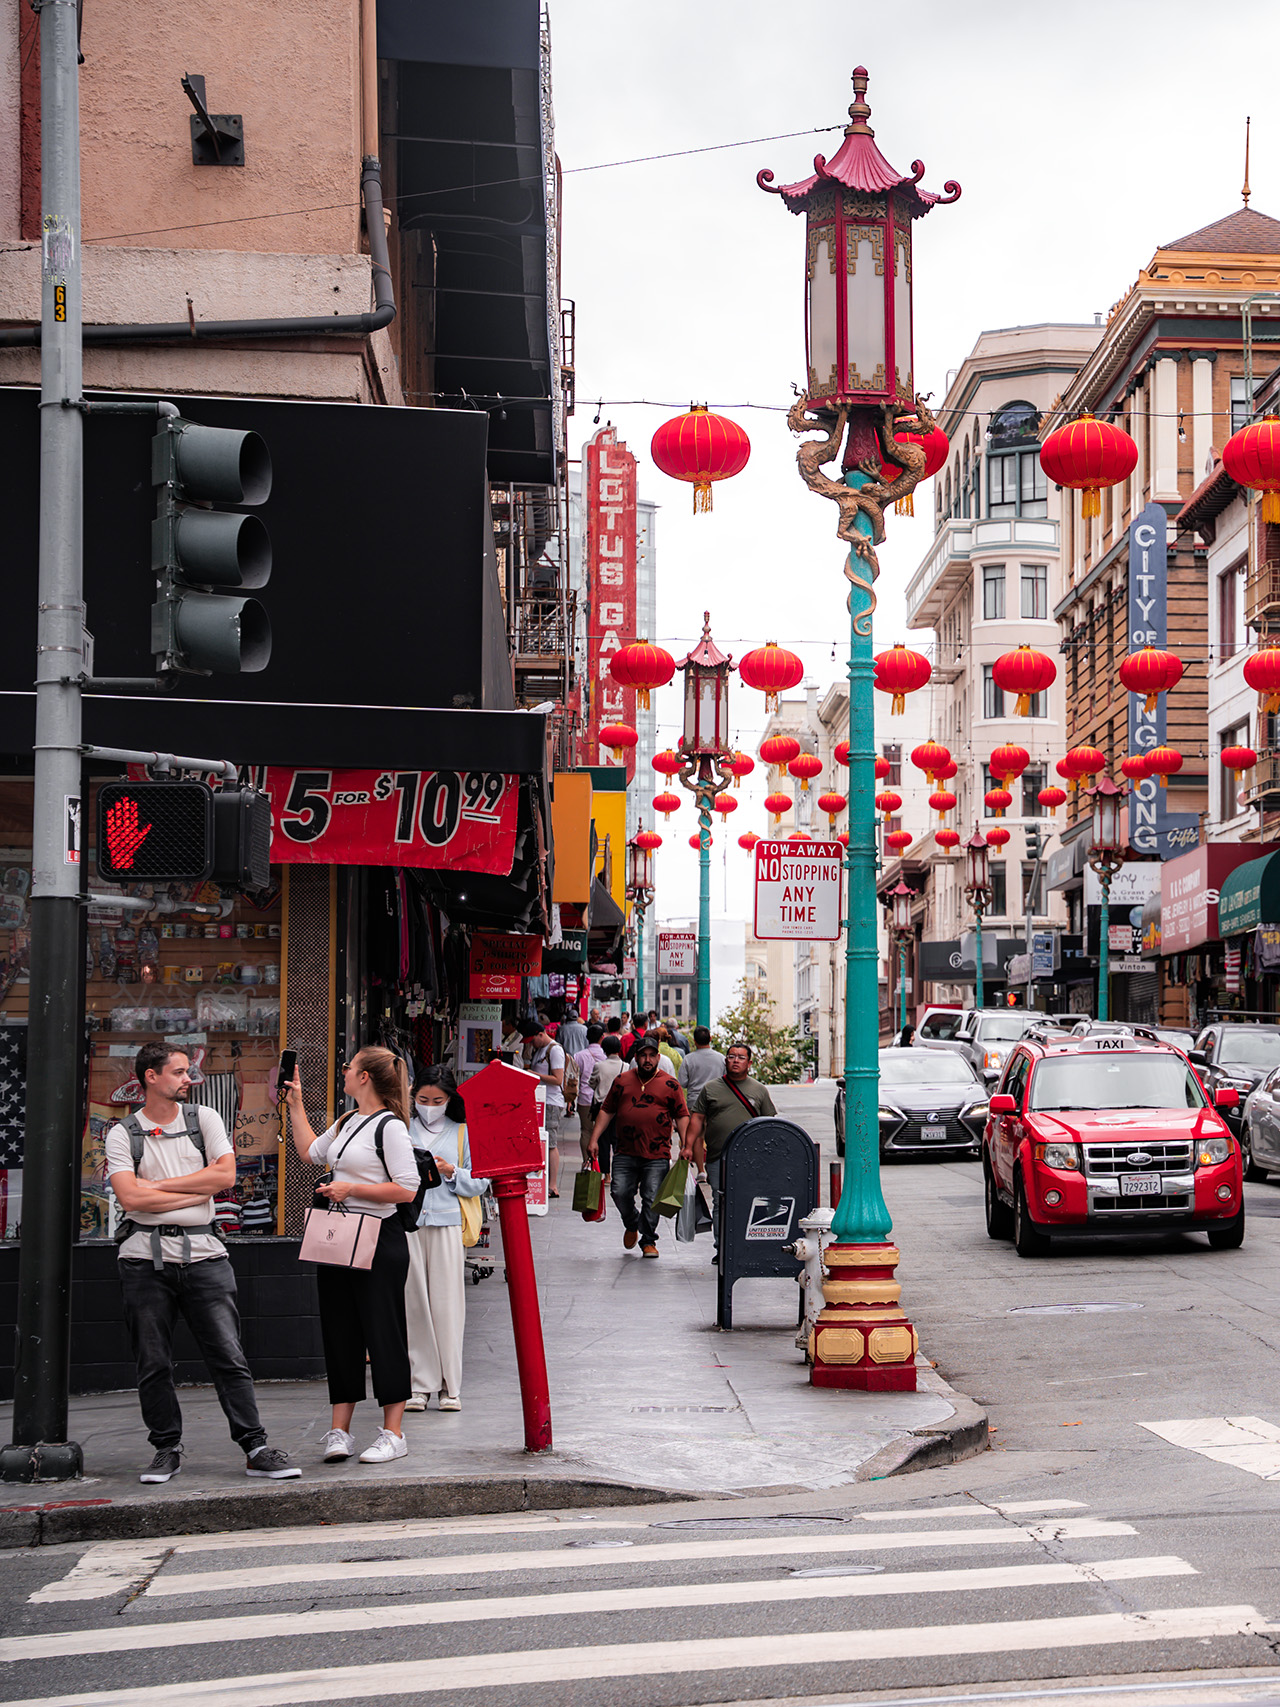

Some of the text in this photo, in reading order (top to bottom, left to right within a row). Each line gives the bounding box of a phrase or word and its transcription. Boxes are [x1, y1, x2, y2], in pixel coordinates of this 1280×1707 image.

[55, 286, 66, 321] 63
[599, 450, 624, 586] LOTUS
[1134, 524, 1157, 621] CITY
[1132, 630, 1158, 644] OF
[280, 769, 333, 844] 5
[332, 791, 370, 806] FOR
[1133, 778, 1158, 848] ONG
[1166, 827, 1199, 848] Gifts
[761, 843, 837, 857] TOW-AWAY
[758, 858, 838, 881] NO STOPPING
[782, 885, 815, 902] ANY
[779, 905, 817, 922] TIME
[482, 940, 528, 950] SPECIAL
[551, 939, 582, 951] TING
[660, 940, 694, 951] NO STOPPING
[483, 950, 528, 960] T-SHIRTS
[669, 951, 684, 959] ANY
[474, 959, 484, 972] 5
[462, 1005, 501, 1013] POST CARD
[1095, 1040, 1124, 1050] TAXI
[1124, 1181, 1158, 1193] 72923T2
